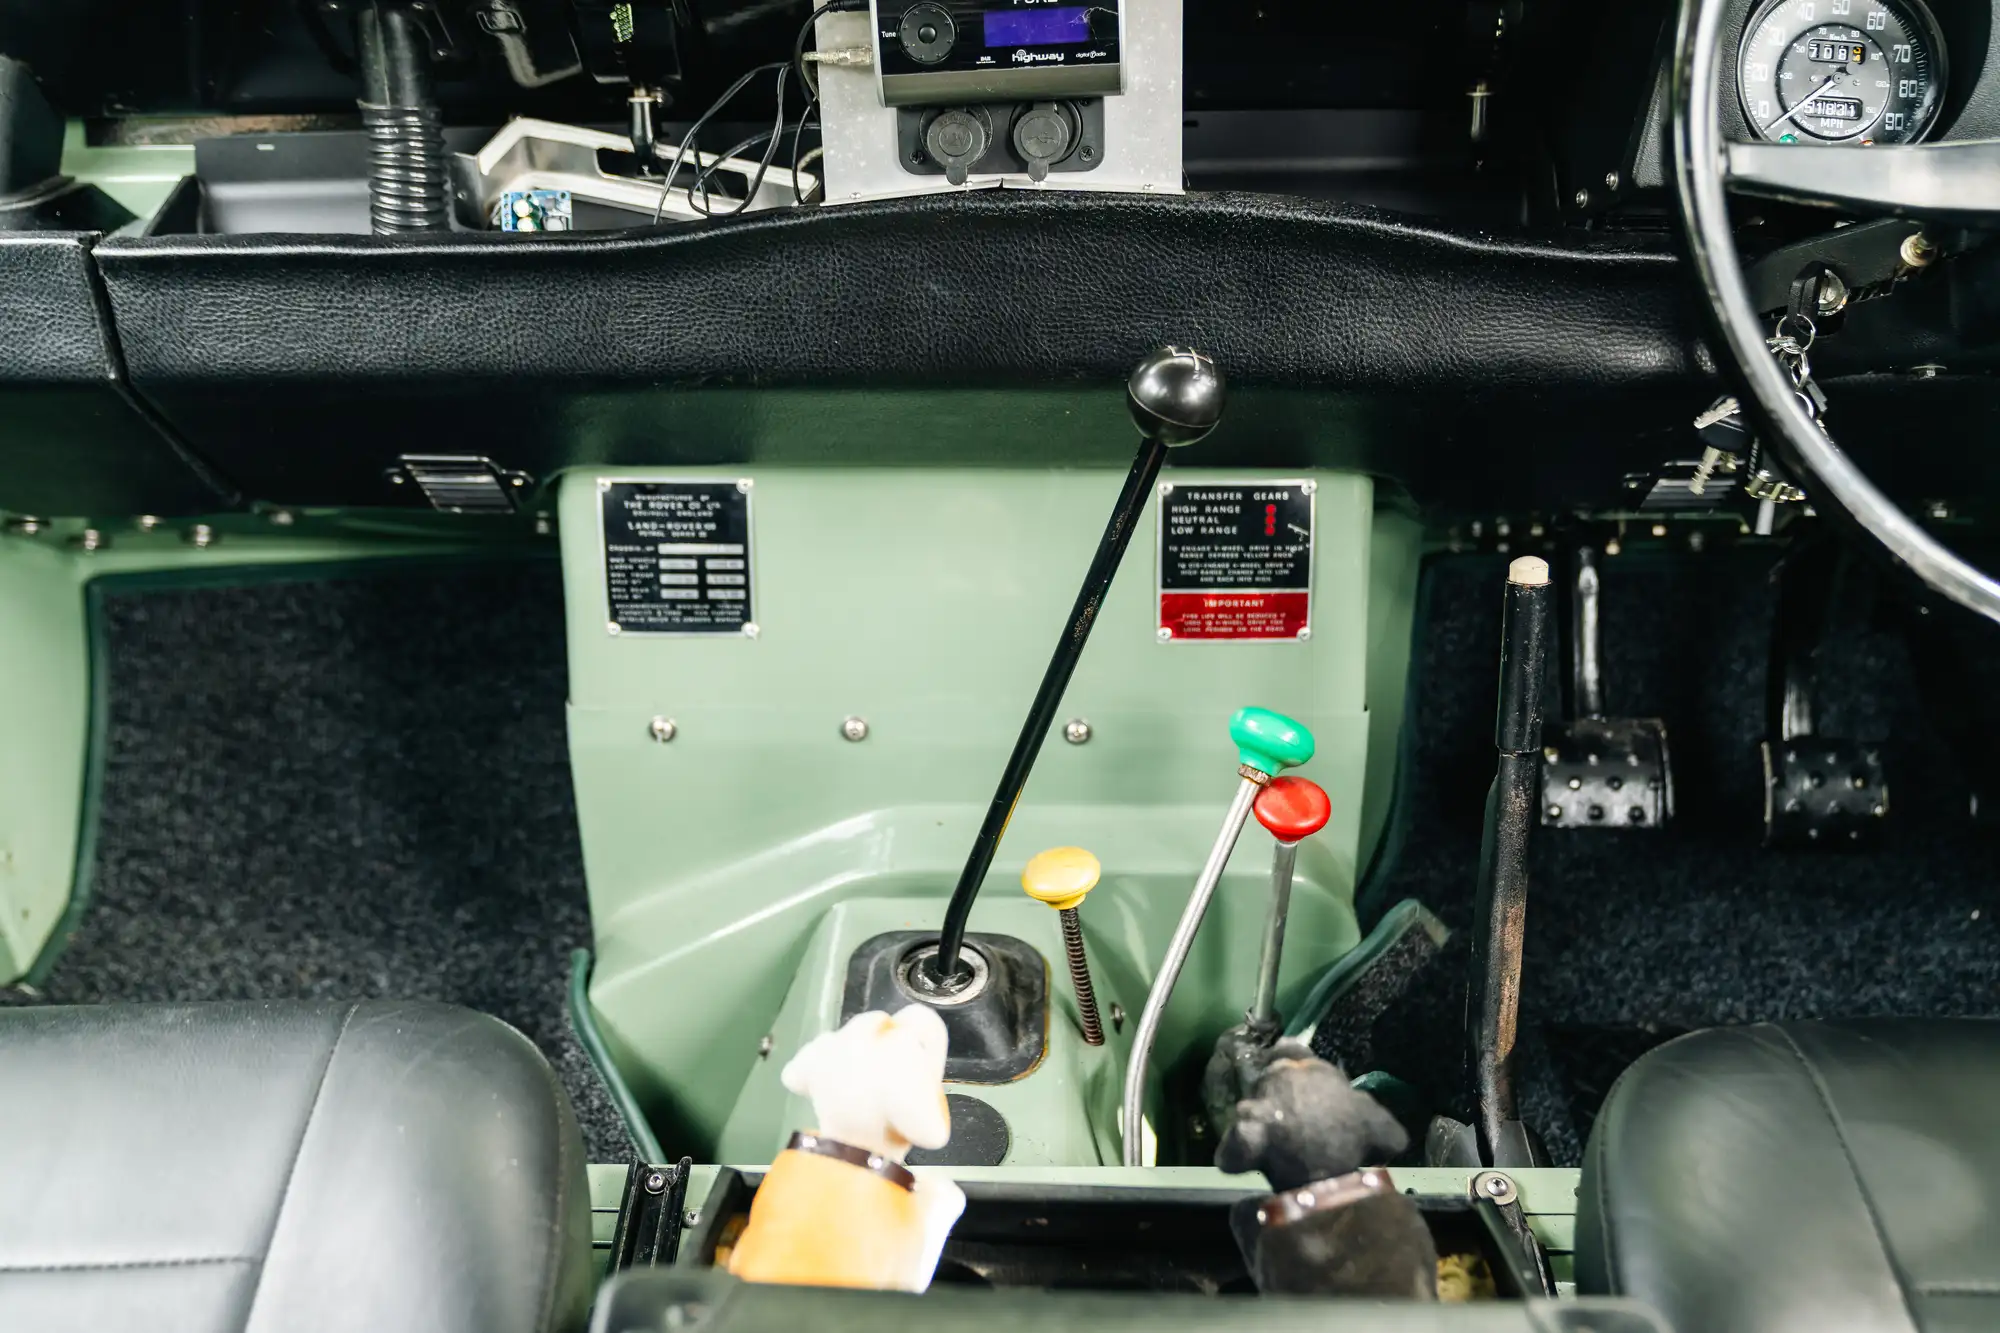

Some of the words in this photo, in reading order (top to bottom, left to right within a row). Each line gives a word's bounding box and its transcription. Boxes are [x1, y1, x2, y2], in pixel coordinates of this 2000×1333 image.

[1797, 4, 1814, 21] 40
[1832, 0, 1850, 14] 50
[1867, 12, 1886, 30] 60
[1012, 49, 1064, 63] highway
[1893, 45, 1911, 62] 70
[1752, 63, 1767, 81] 20
[1899, 80, 1918, 98] 80
[1820, 118, 1843, 129] MPH
[1886, 112, 1904, 130] 90
[1187, 492, 1243, 500] TRANSFER
[1253, 491, 1289, 500] GEARS
[624, 501, 642, 509] THE
[649, 501, 684, 509] ROVER
[1171, 505, 1197, 514] HIGH
[1205, 505, 1241, 514] RANGE
[627, 521, 701, 530] LAND-ROVER
[1171, 515, 1220, 524] NEUTRAL
[1171, 526, 1194, 535] LOW
[1200, 526, 1238, 535] RANGE
[1204, 599, 1264, 607] IMPORTANT
